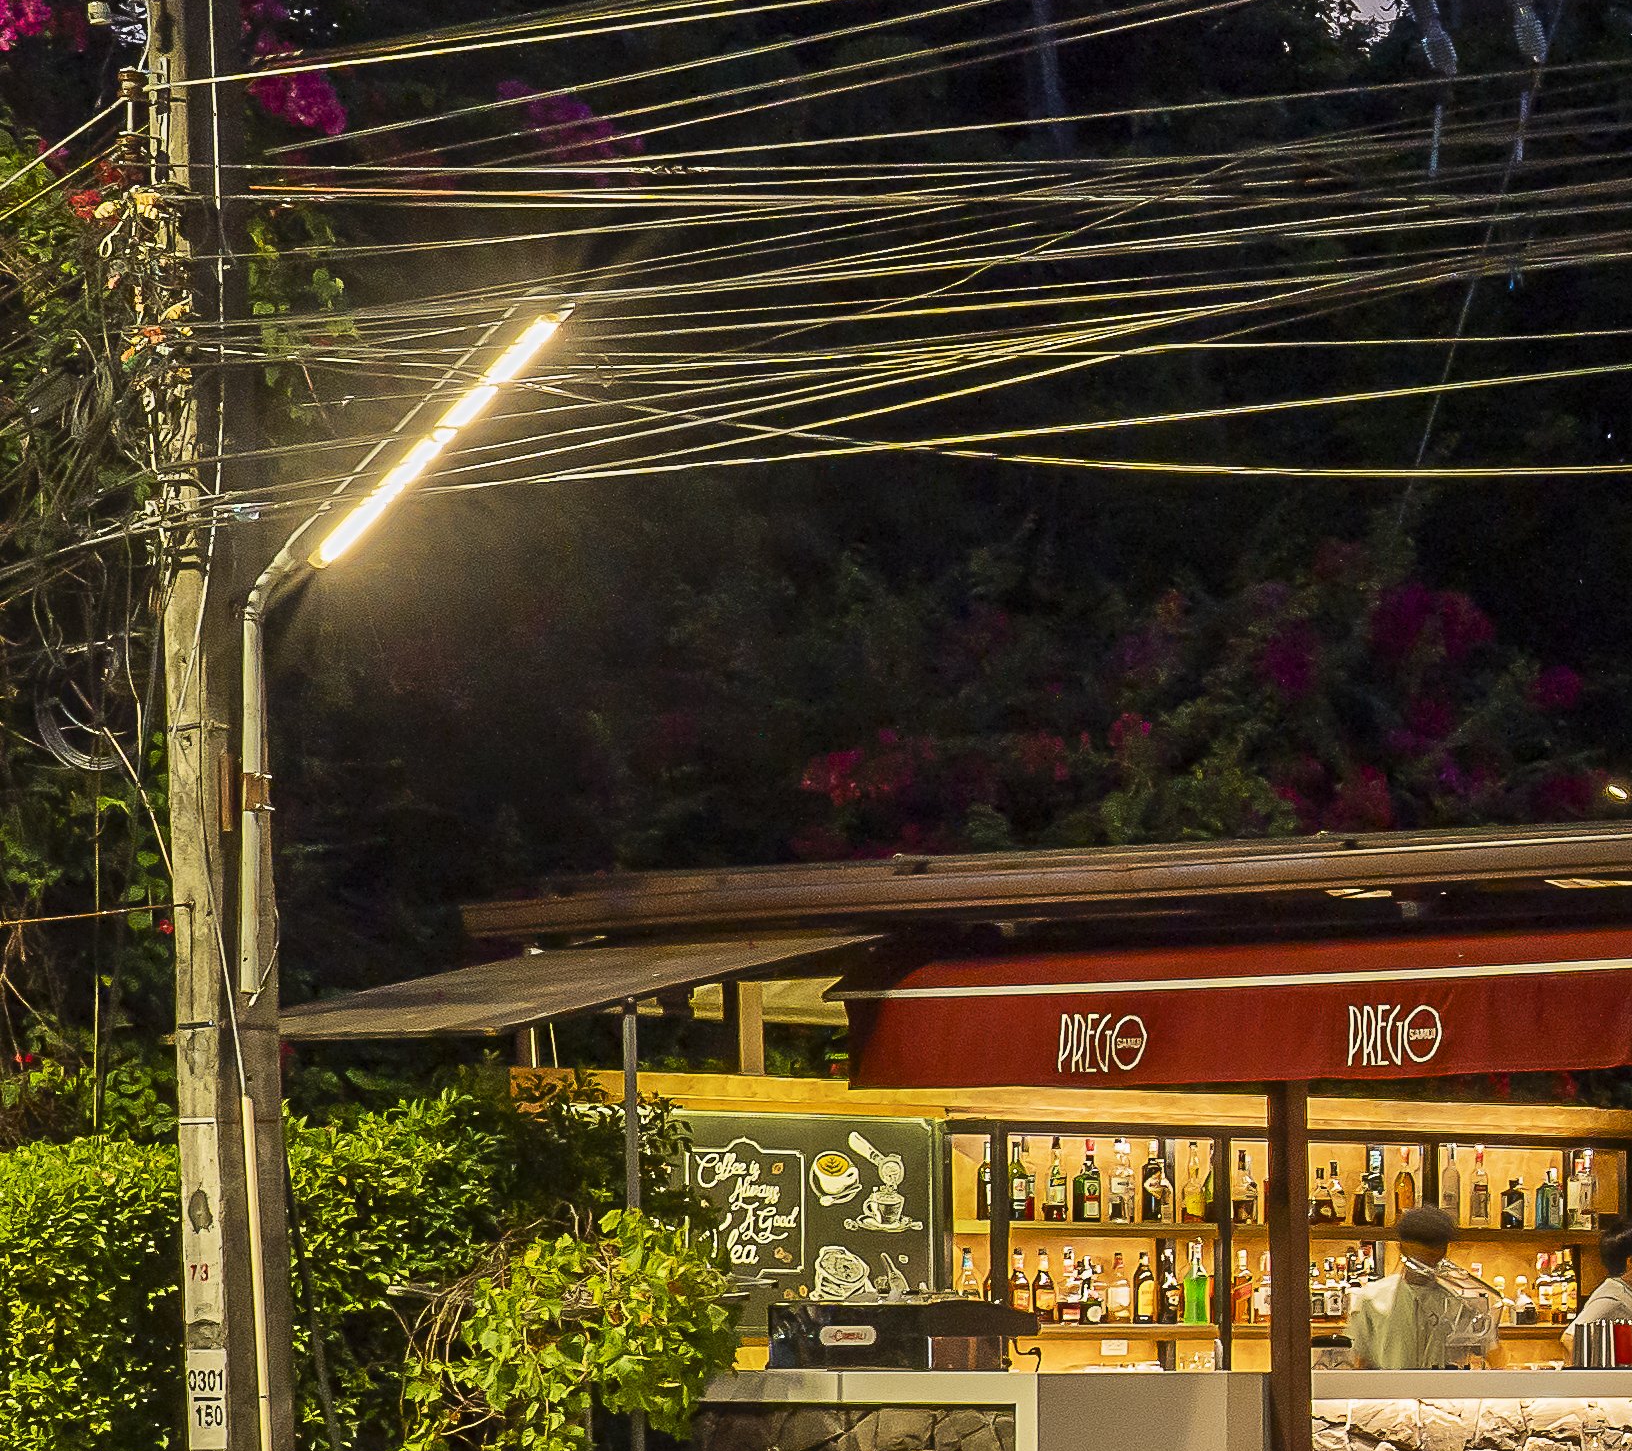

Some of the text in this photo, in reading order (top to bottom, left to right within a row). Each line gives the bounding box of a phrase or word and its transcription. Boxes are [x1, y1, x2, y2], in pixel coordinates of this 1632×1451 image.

[1058, 1013, 1147, 1073] PREGO
[1347, 1004, 1442, 1067] PREGO
[695, 1152, 748, 1188] Coffee
[729, 1176, 781, 1210] Always
[755, 1206, 800, 1244] Good
[188, 1369, 223, 1392] 0301
[195, 1404, 223, 1426] 150
